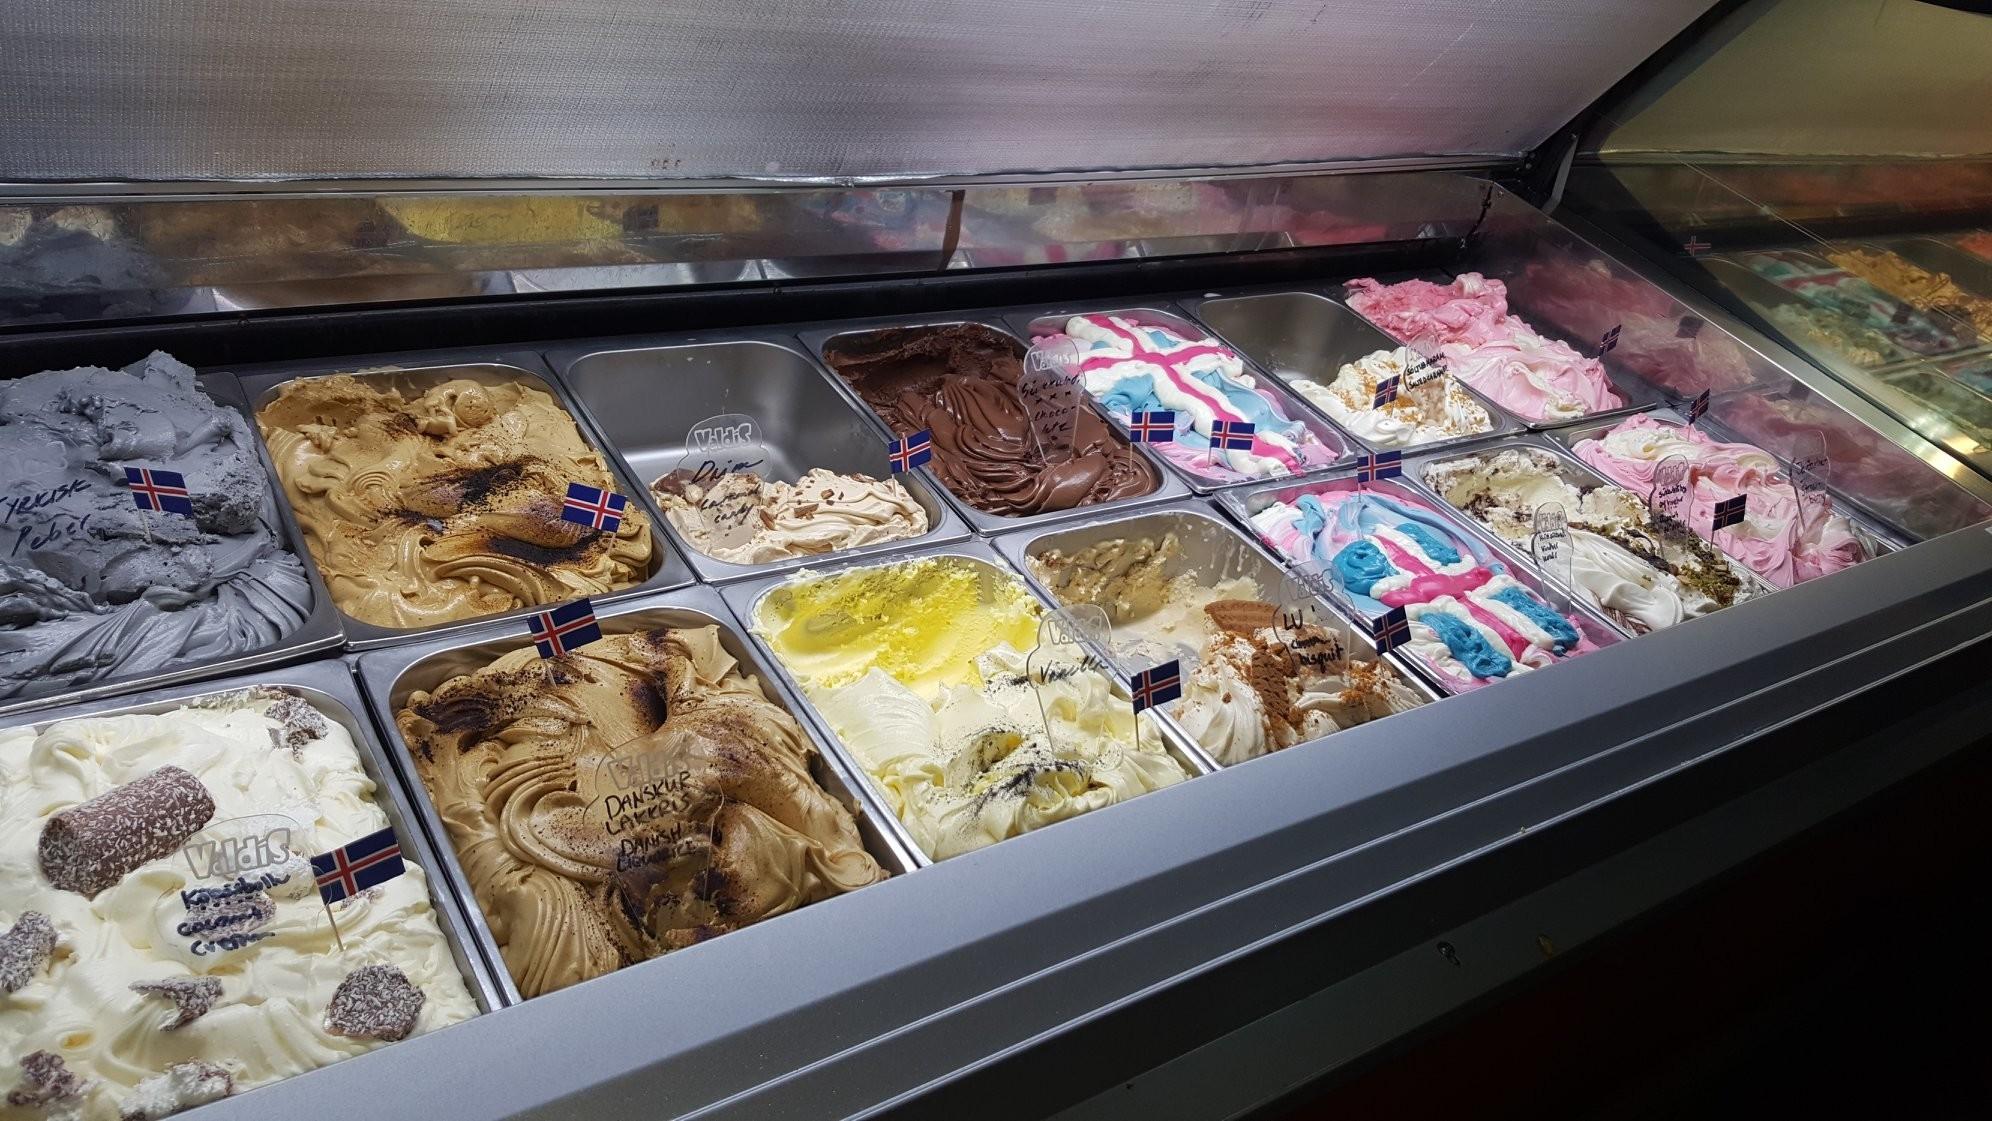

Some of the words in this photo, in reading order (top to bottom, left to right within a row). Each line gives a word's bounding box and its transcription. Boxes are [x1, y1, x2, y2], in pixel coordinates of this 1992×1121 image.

[11, 513, 92, 557] Peber
[604, 770, 692, 820] DANSKUR
[604, 792, 691, 836] LAKKRIS
